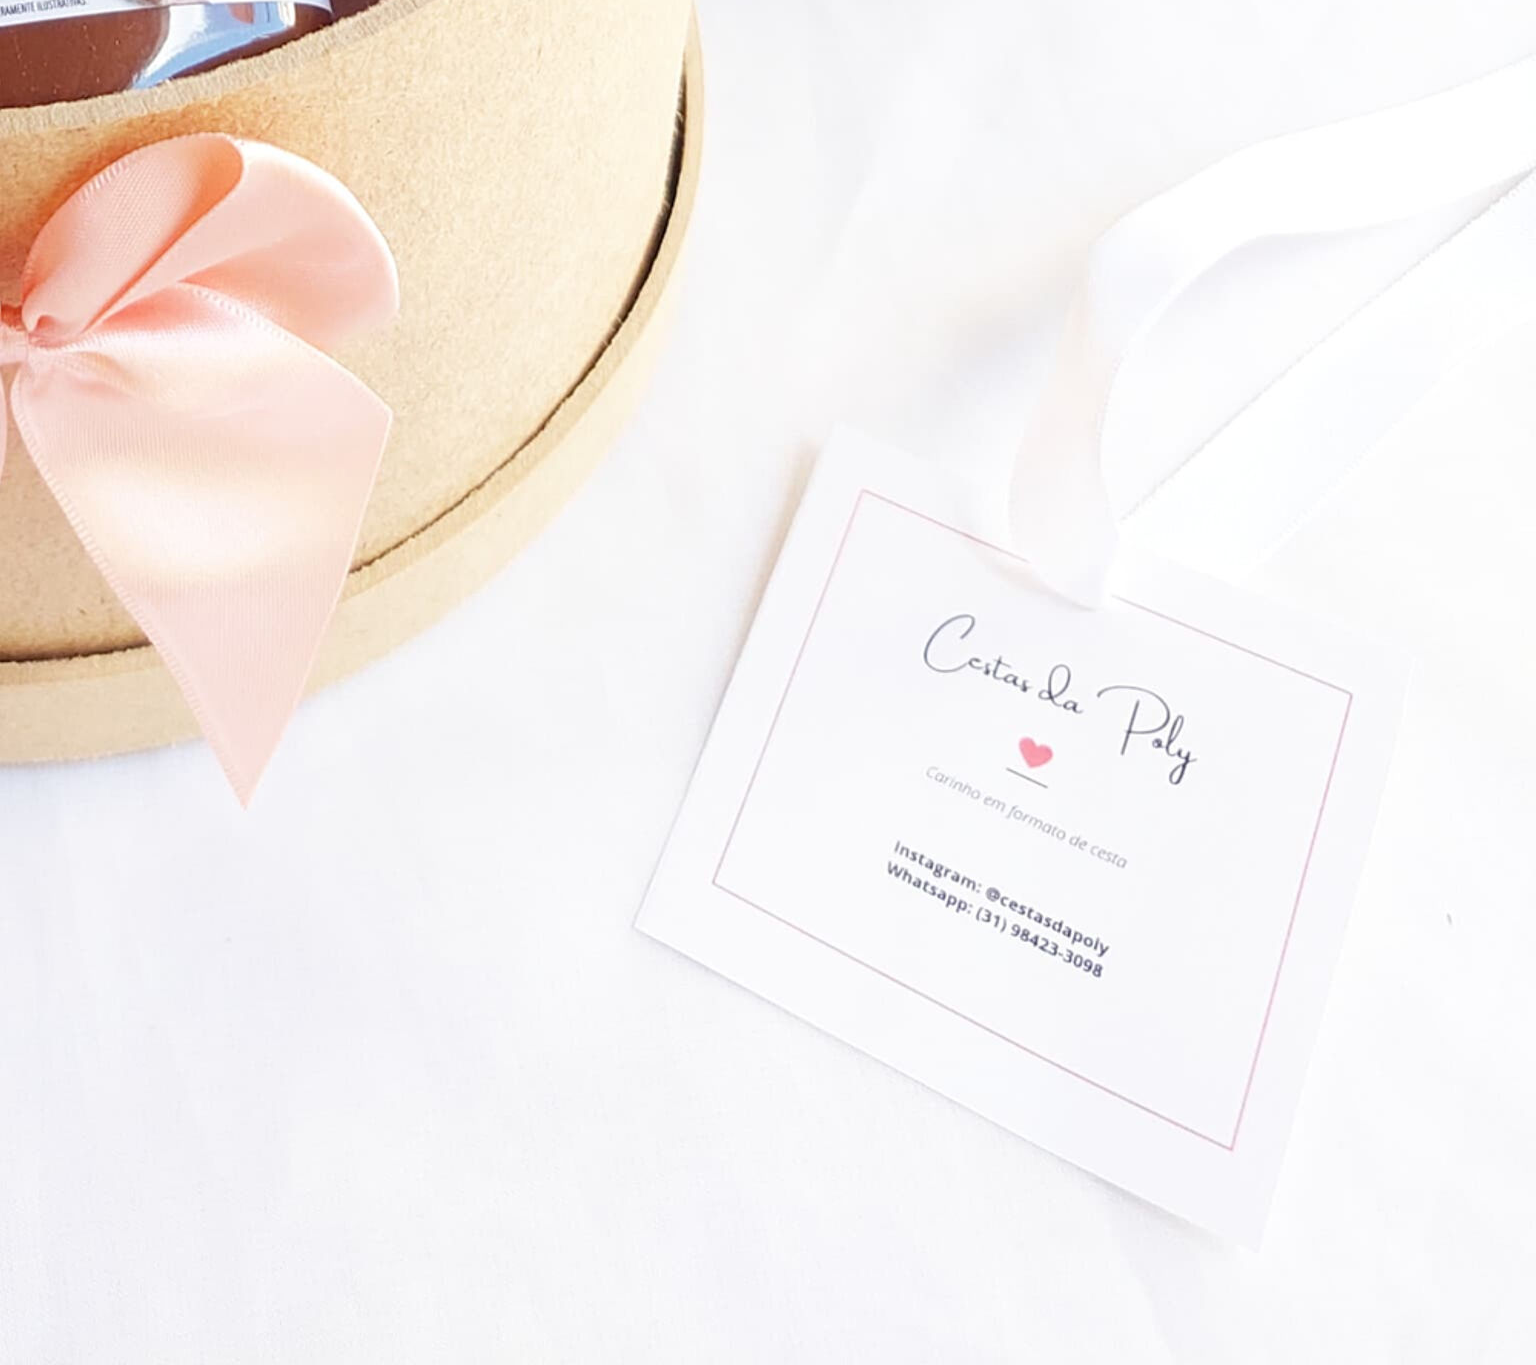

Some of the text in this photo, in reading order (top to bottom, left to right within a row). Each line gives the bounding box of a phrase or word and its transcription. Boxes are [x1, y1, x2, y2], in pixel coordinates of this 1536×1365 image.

[923, 614, 1197, 785] Cestas da Poly
[925, 765, 1128, 870] Carinho em formato de cesta
[887, 860, 1104, 978] Whatsapp: (31) 98423-3098
[893, 840, 1110, 958] Instagram: @cestasdapoly
